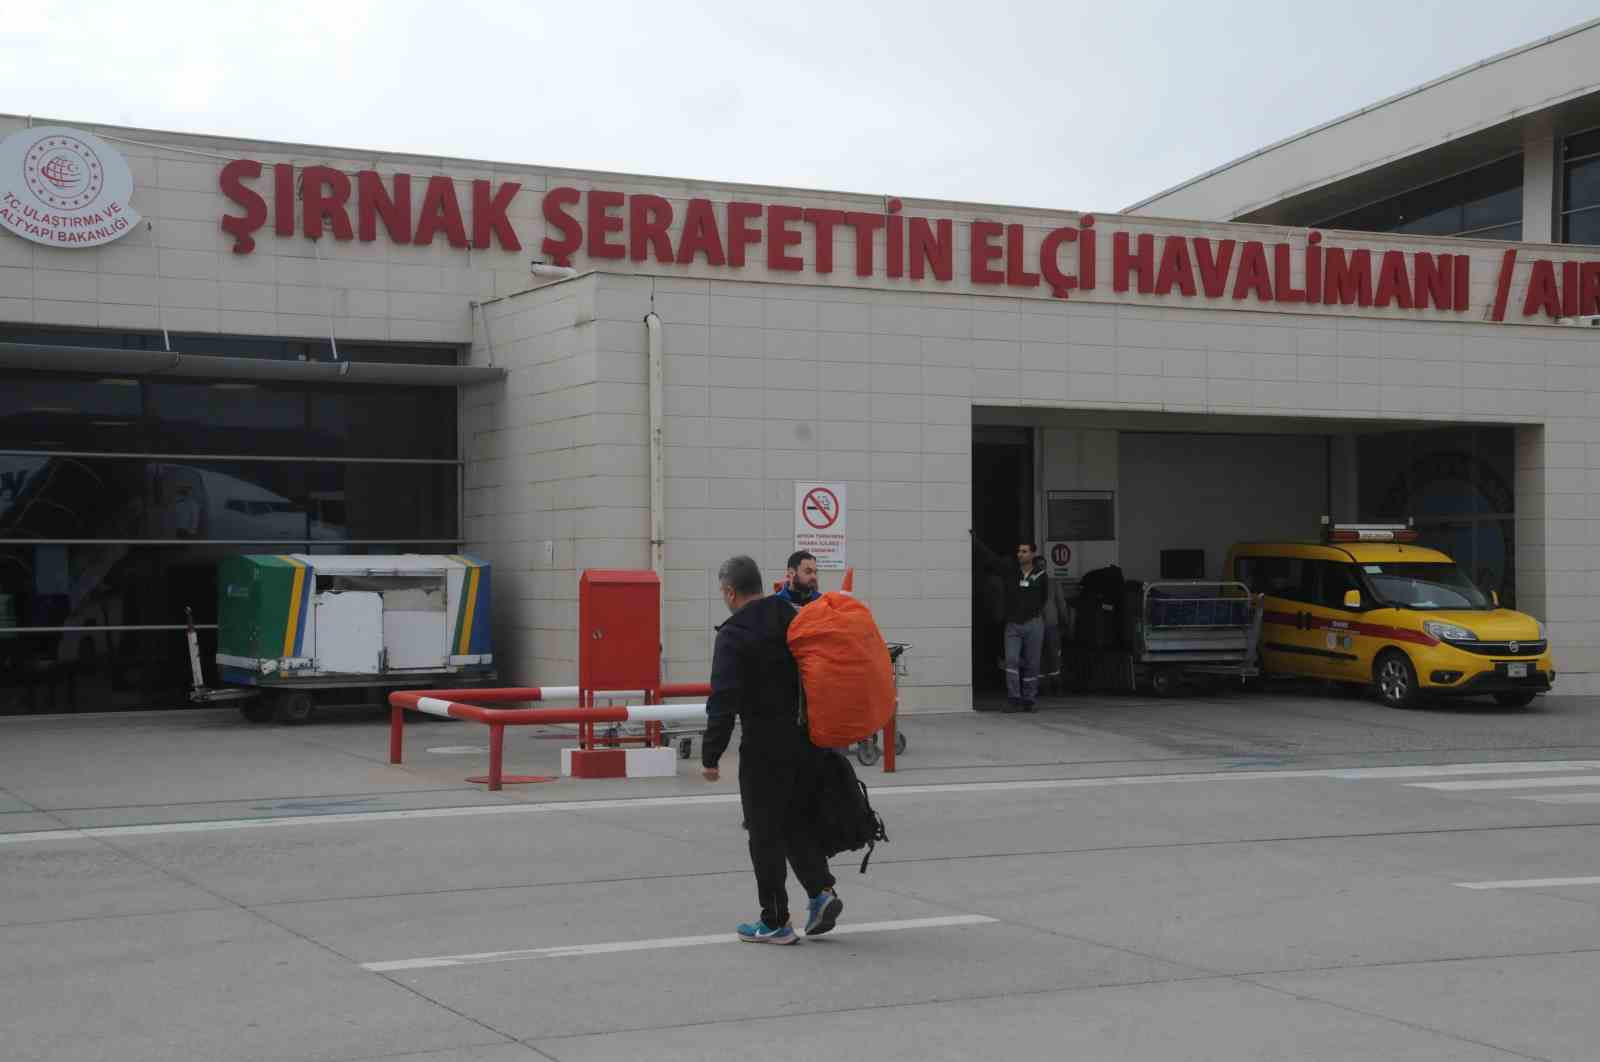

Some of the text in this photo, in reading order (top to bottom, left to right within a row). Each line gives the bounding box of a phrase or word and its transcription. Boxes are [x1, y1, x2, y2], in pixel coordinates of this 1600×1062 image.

[103, 201, 122, 218] VE
[0, 208, 54, 240] ALTYAPI
[219, 160, 522, 254] ŞIRNAK
[541, 187, 953, 281] ŞERAFETTİN
[970, 214, 1096, 299] ELÇİ
[1113, 231, 1470, 311] HAVALİMANI
[1055, 547, 1069, 561] 10
